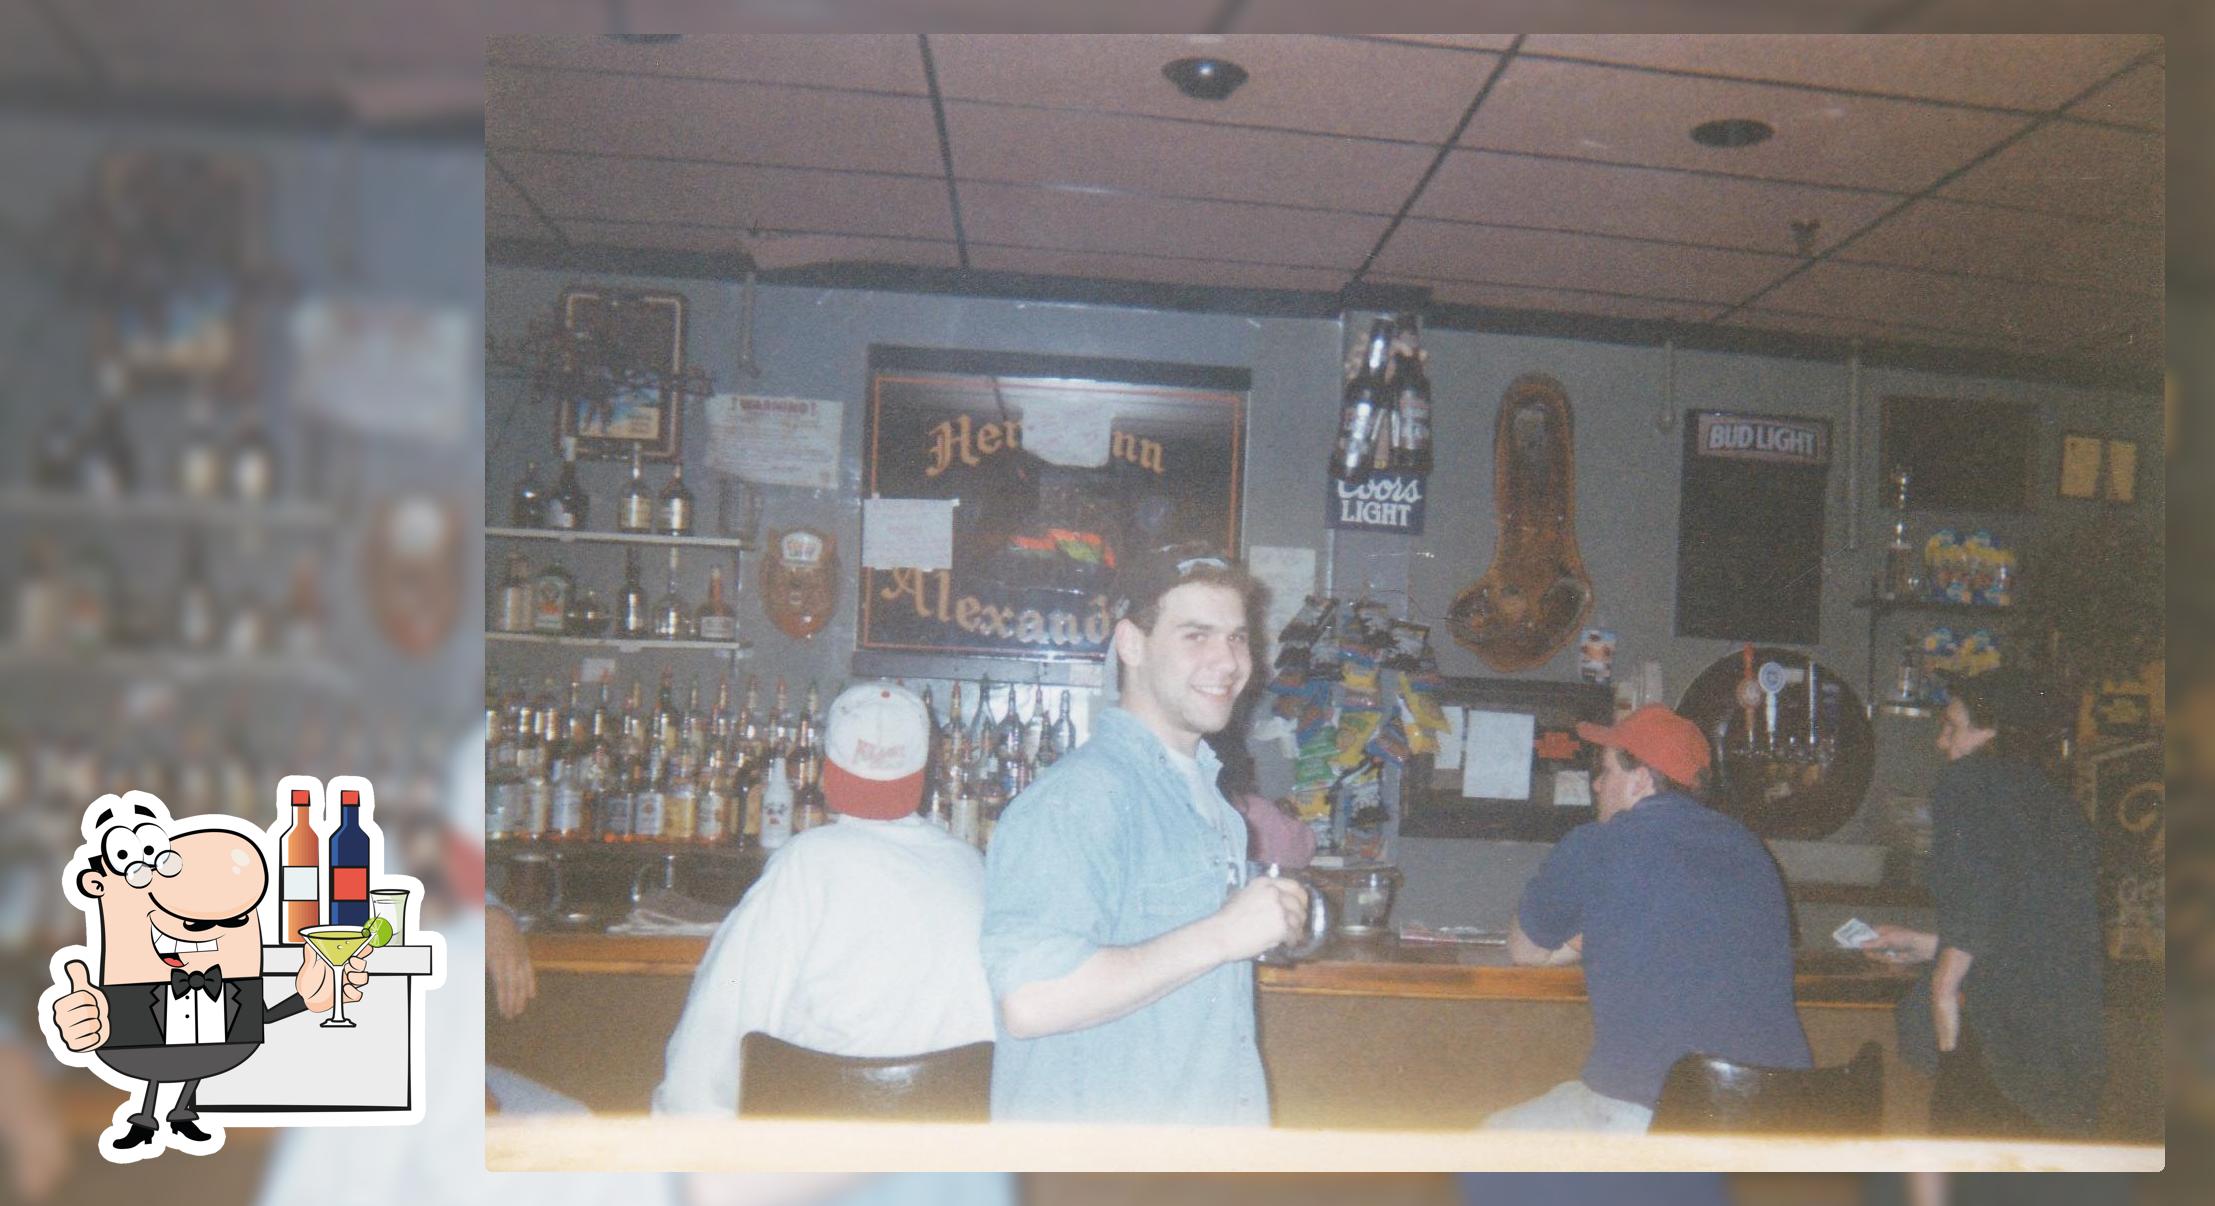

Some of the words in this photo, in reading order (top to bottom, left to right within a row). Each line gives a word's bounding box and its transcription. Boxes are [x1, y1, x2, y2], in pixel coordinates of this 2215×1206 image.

[925, 413, 1165, 478] Hernn
[1708, 423, 1754, 449] BUD
[1756, 425, 1817, 456] LIGHT
[1340, 499, 1412, 527] LIGHT
[880, 568, 1112, 645] Alexand
